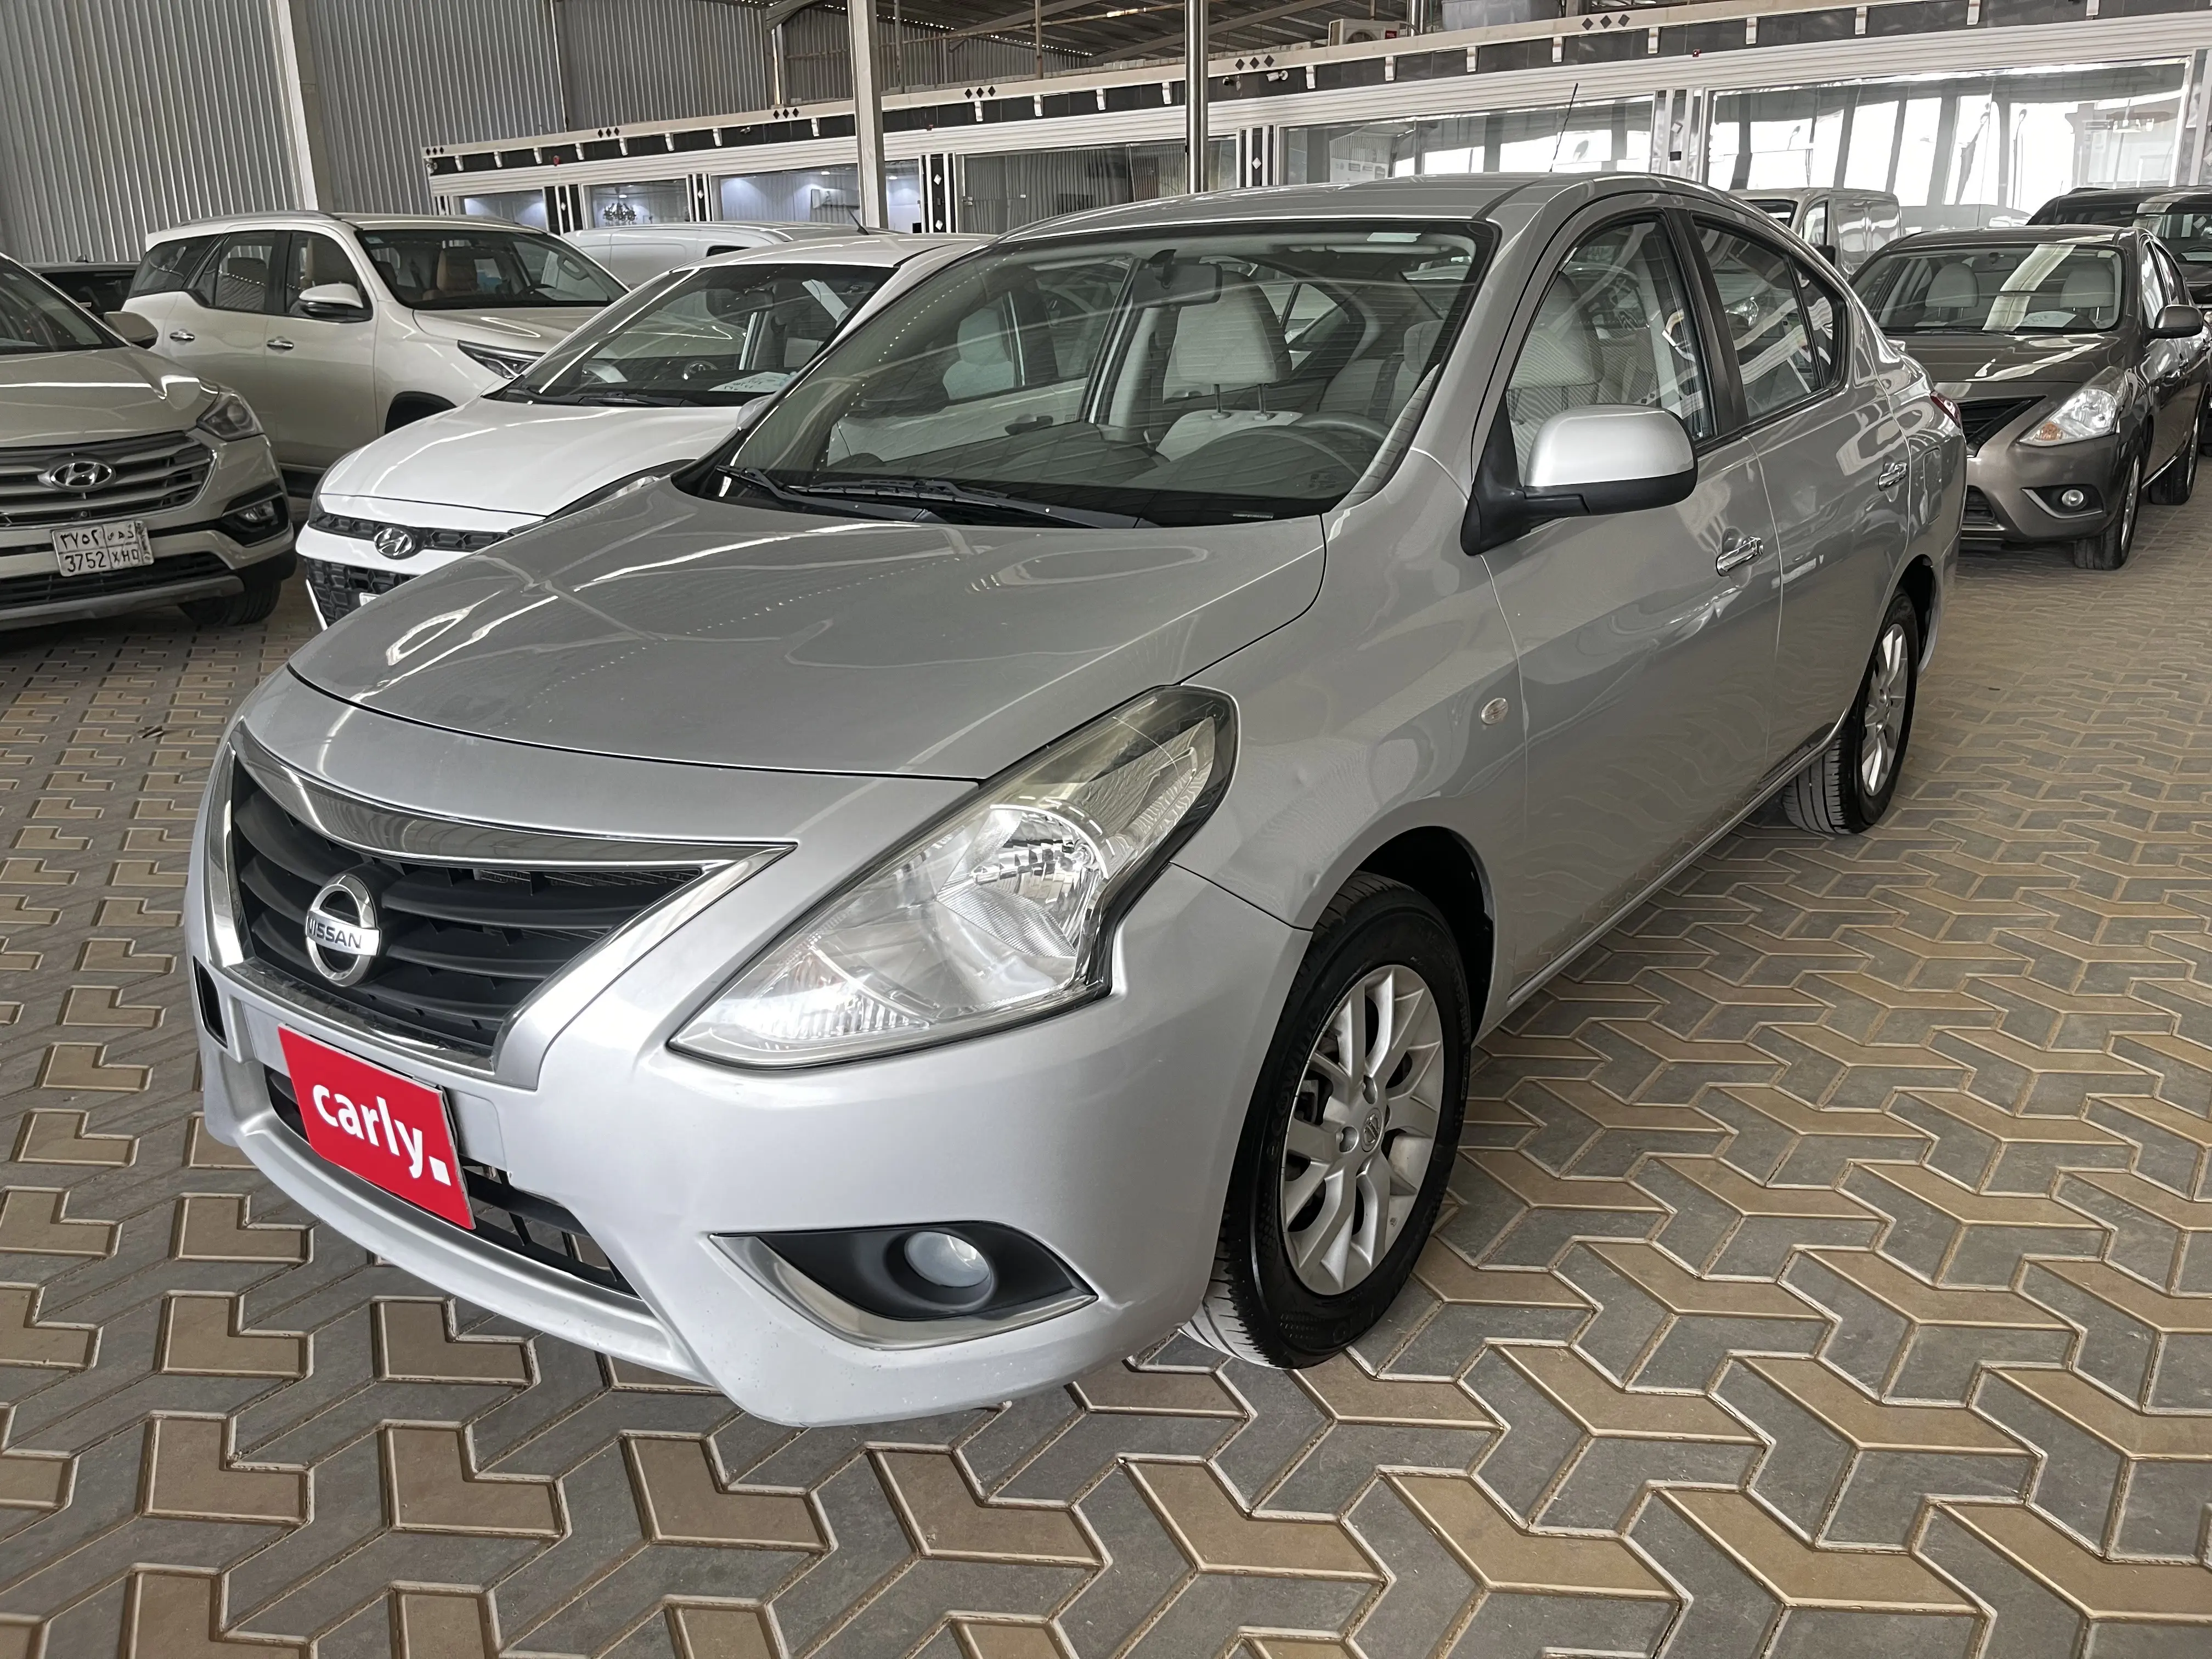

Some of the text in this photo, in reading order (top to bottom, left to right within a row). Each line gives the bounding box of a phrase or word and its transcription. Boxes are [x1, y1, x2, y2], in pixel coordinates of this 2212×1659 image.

[65, 549, 139, 573] 3752 XHD
[306, 914, 362, 949] NISSAN
